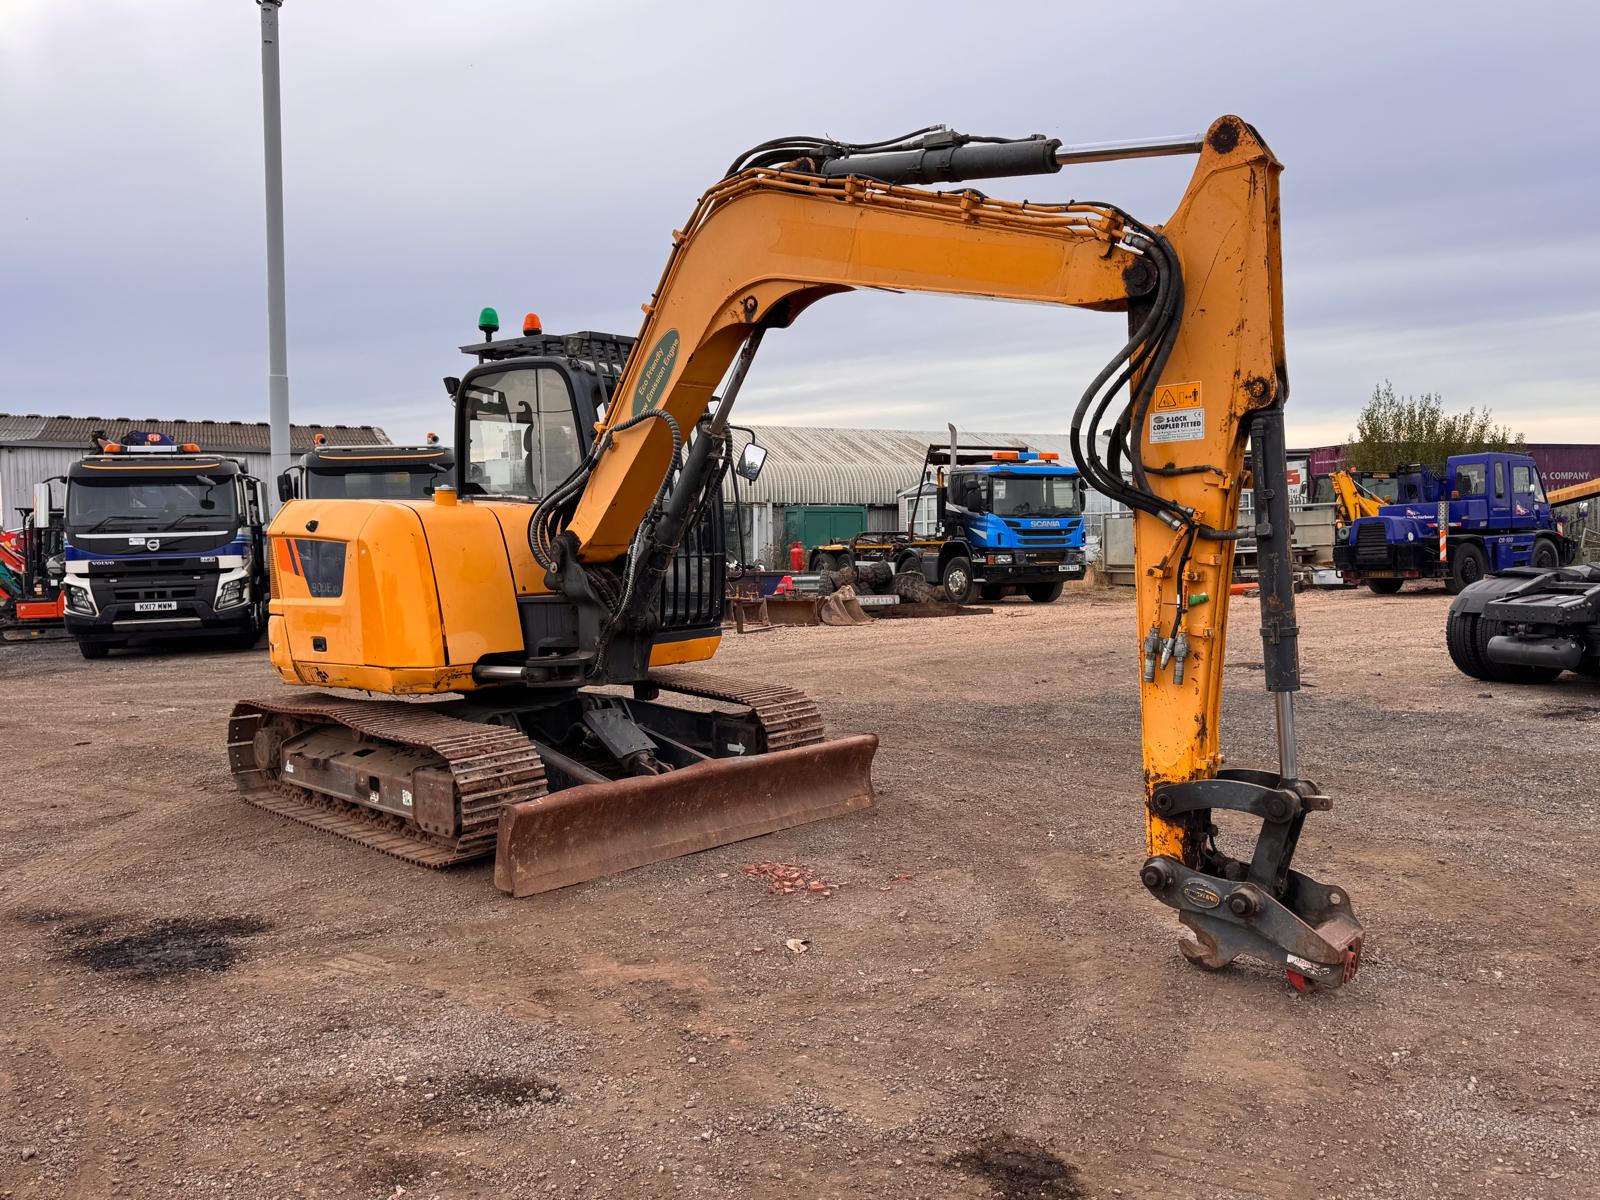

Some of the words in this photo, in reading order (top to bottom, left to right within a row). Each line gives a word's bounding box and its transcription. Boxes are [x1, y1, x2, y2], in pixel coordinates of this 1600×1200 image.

[639, 380, 649, 395] Eco
[645, 347, 664, 379] Friendly
[646, 366, 666, 402] Emission
[663, 338, 679, 366] Engine
[1166, 415, 1188, 423] S-LOCK
[1153, 422, 1180, 430] COUPLER
[1549, 471, 1590, 480] COMPANY
[1030, 520, 1061, 528] SCANIA
[139, 602, 156, 610] KX17
